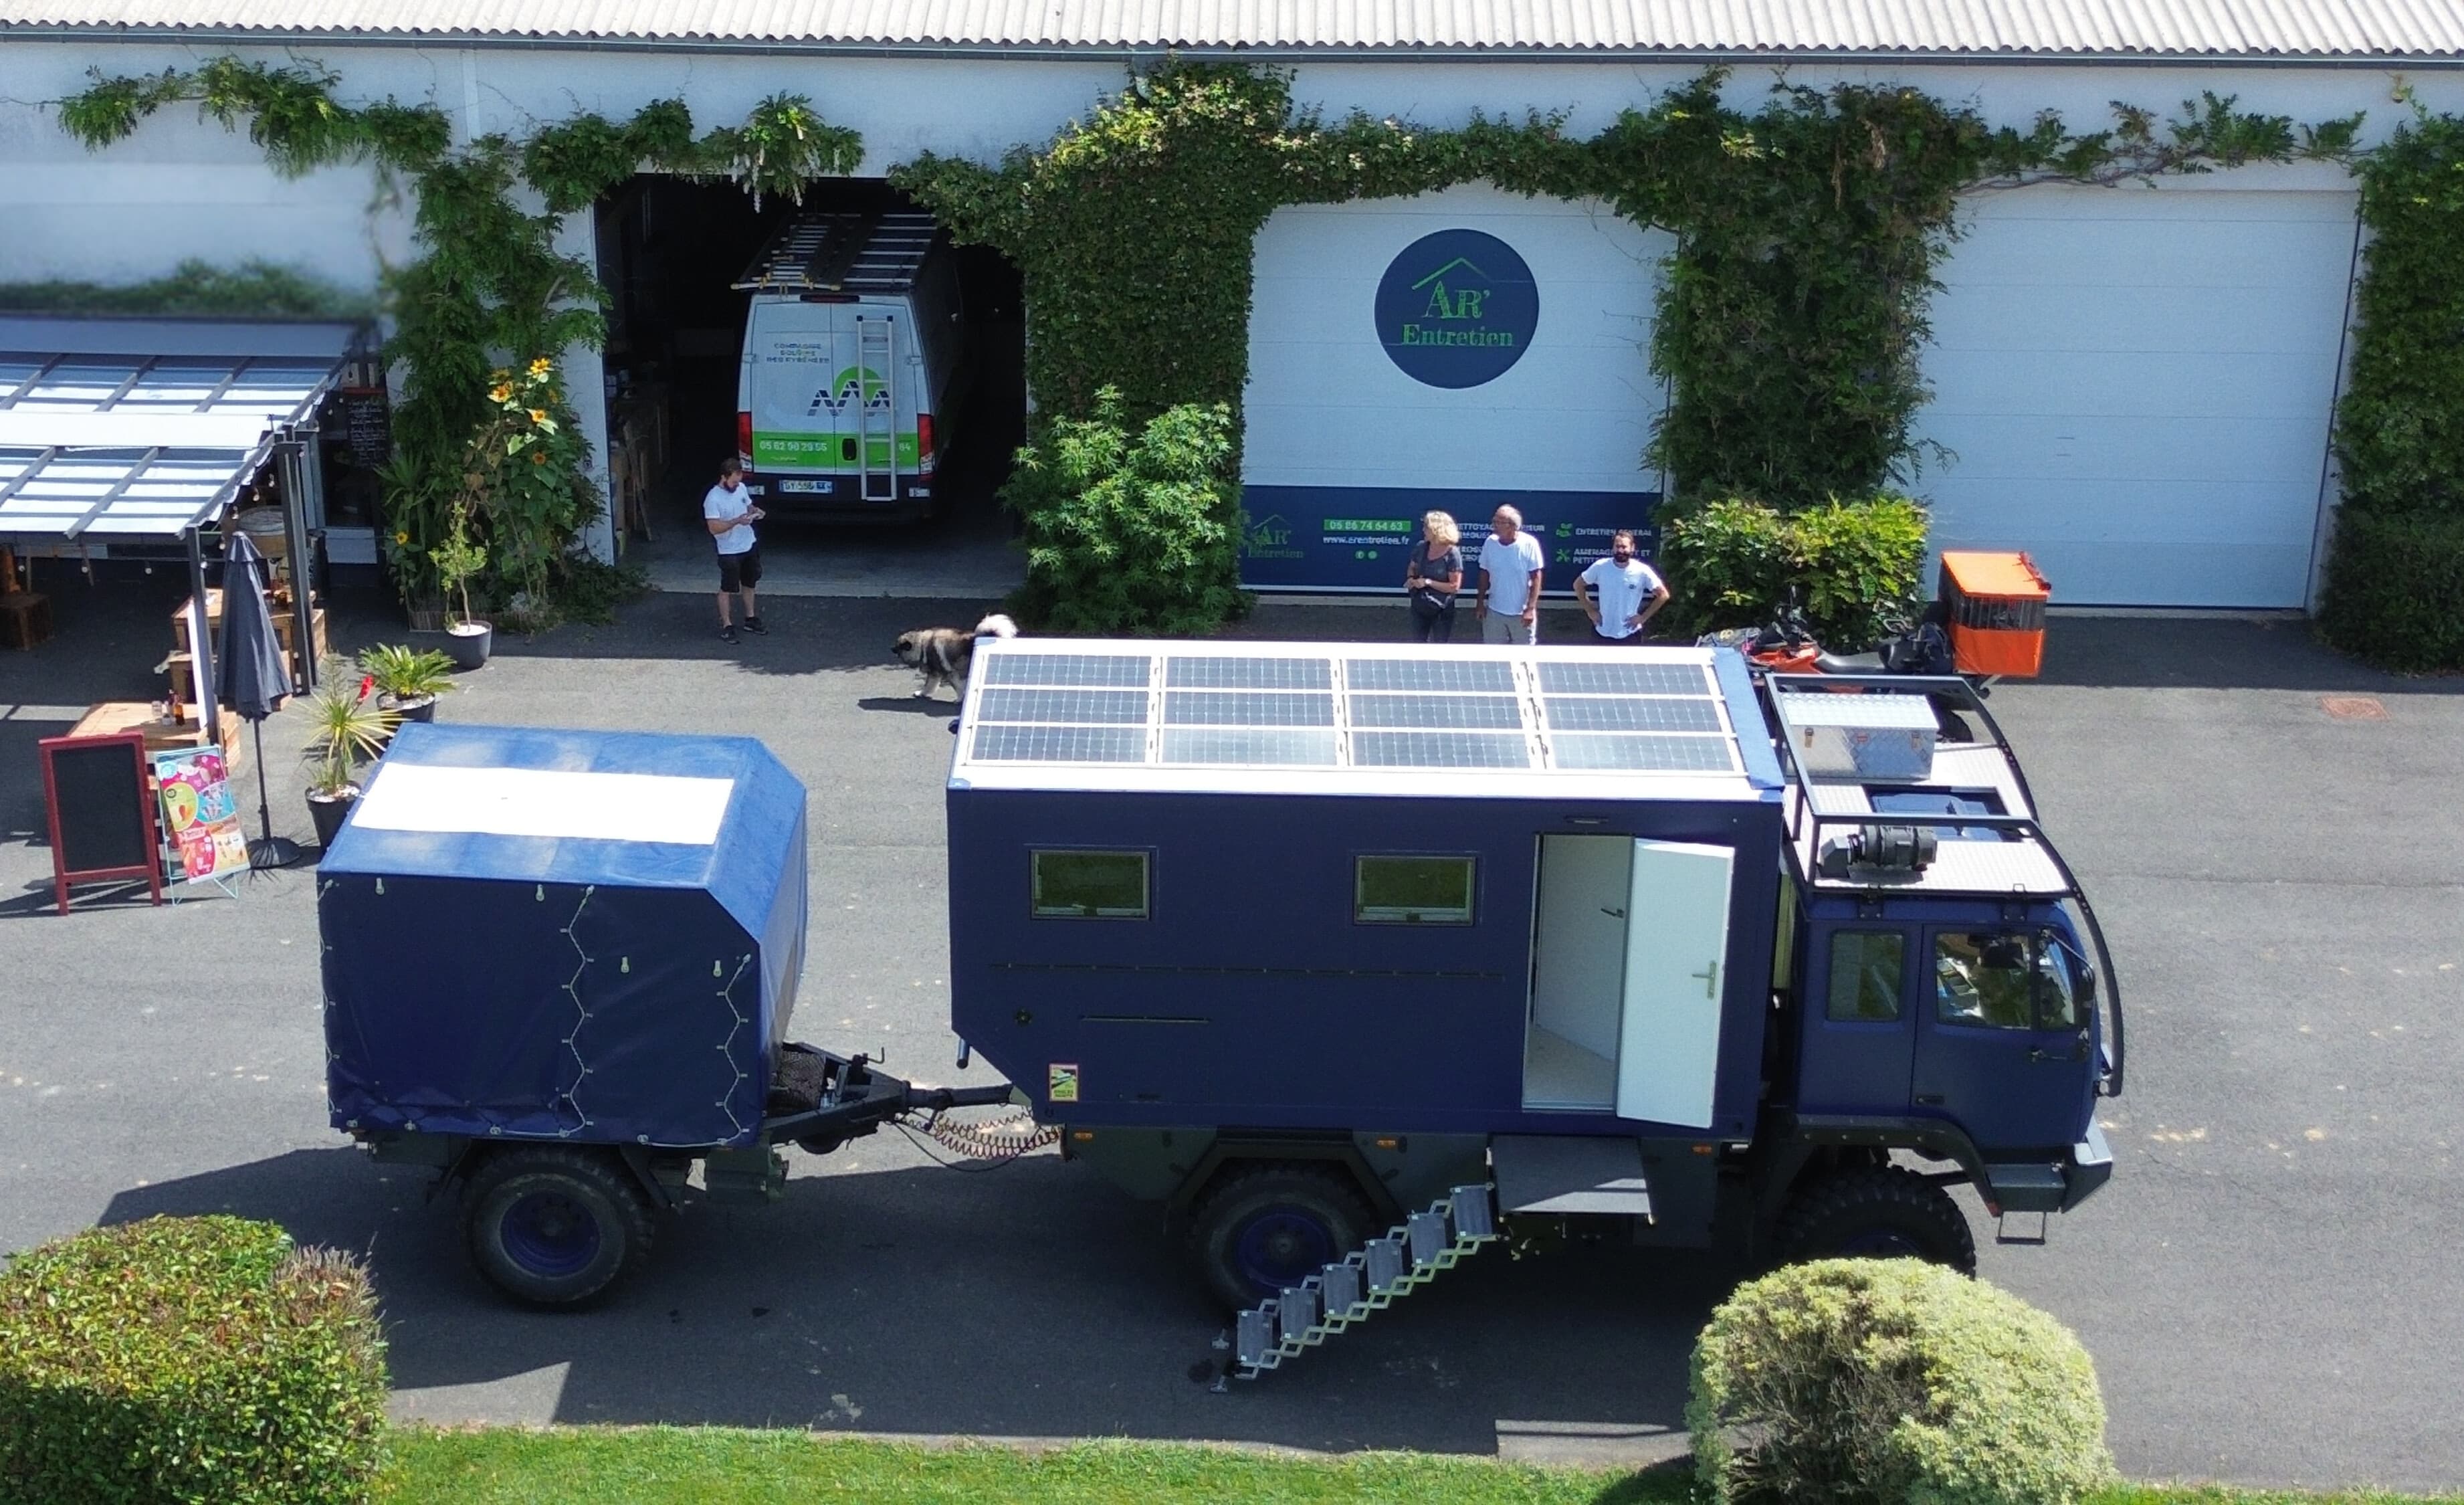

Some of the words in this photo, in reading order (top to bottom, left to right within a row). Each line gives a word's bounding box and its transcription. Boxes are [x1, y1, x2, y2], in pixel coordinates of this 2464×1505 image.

[1403, 324, 1513, 346] Entretien
[1330, 520, 1342, 530] 05
[1360, 521, 1372, 530] 74
[1374, 522, 1388, 530] 64
[1390, 522, 1403, 530] 63
